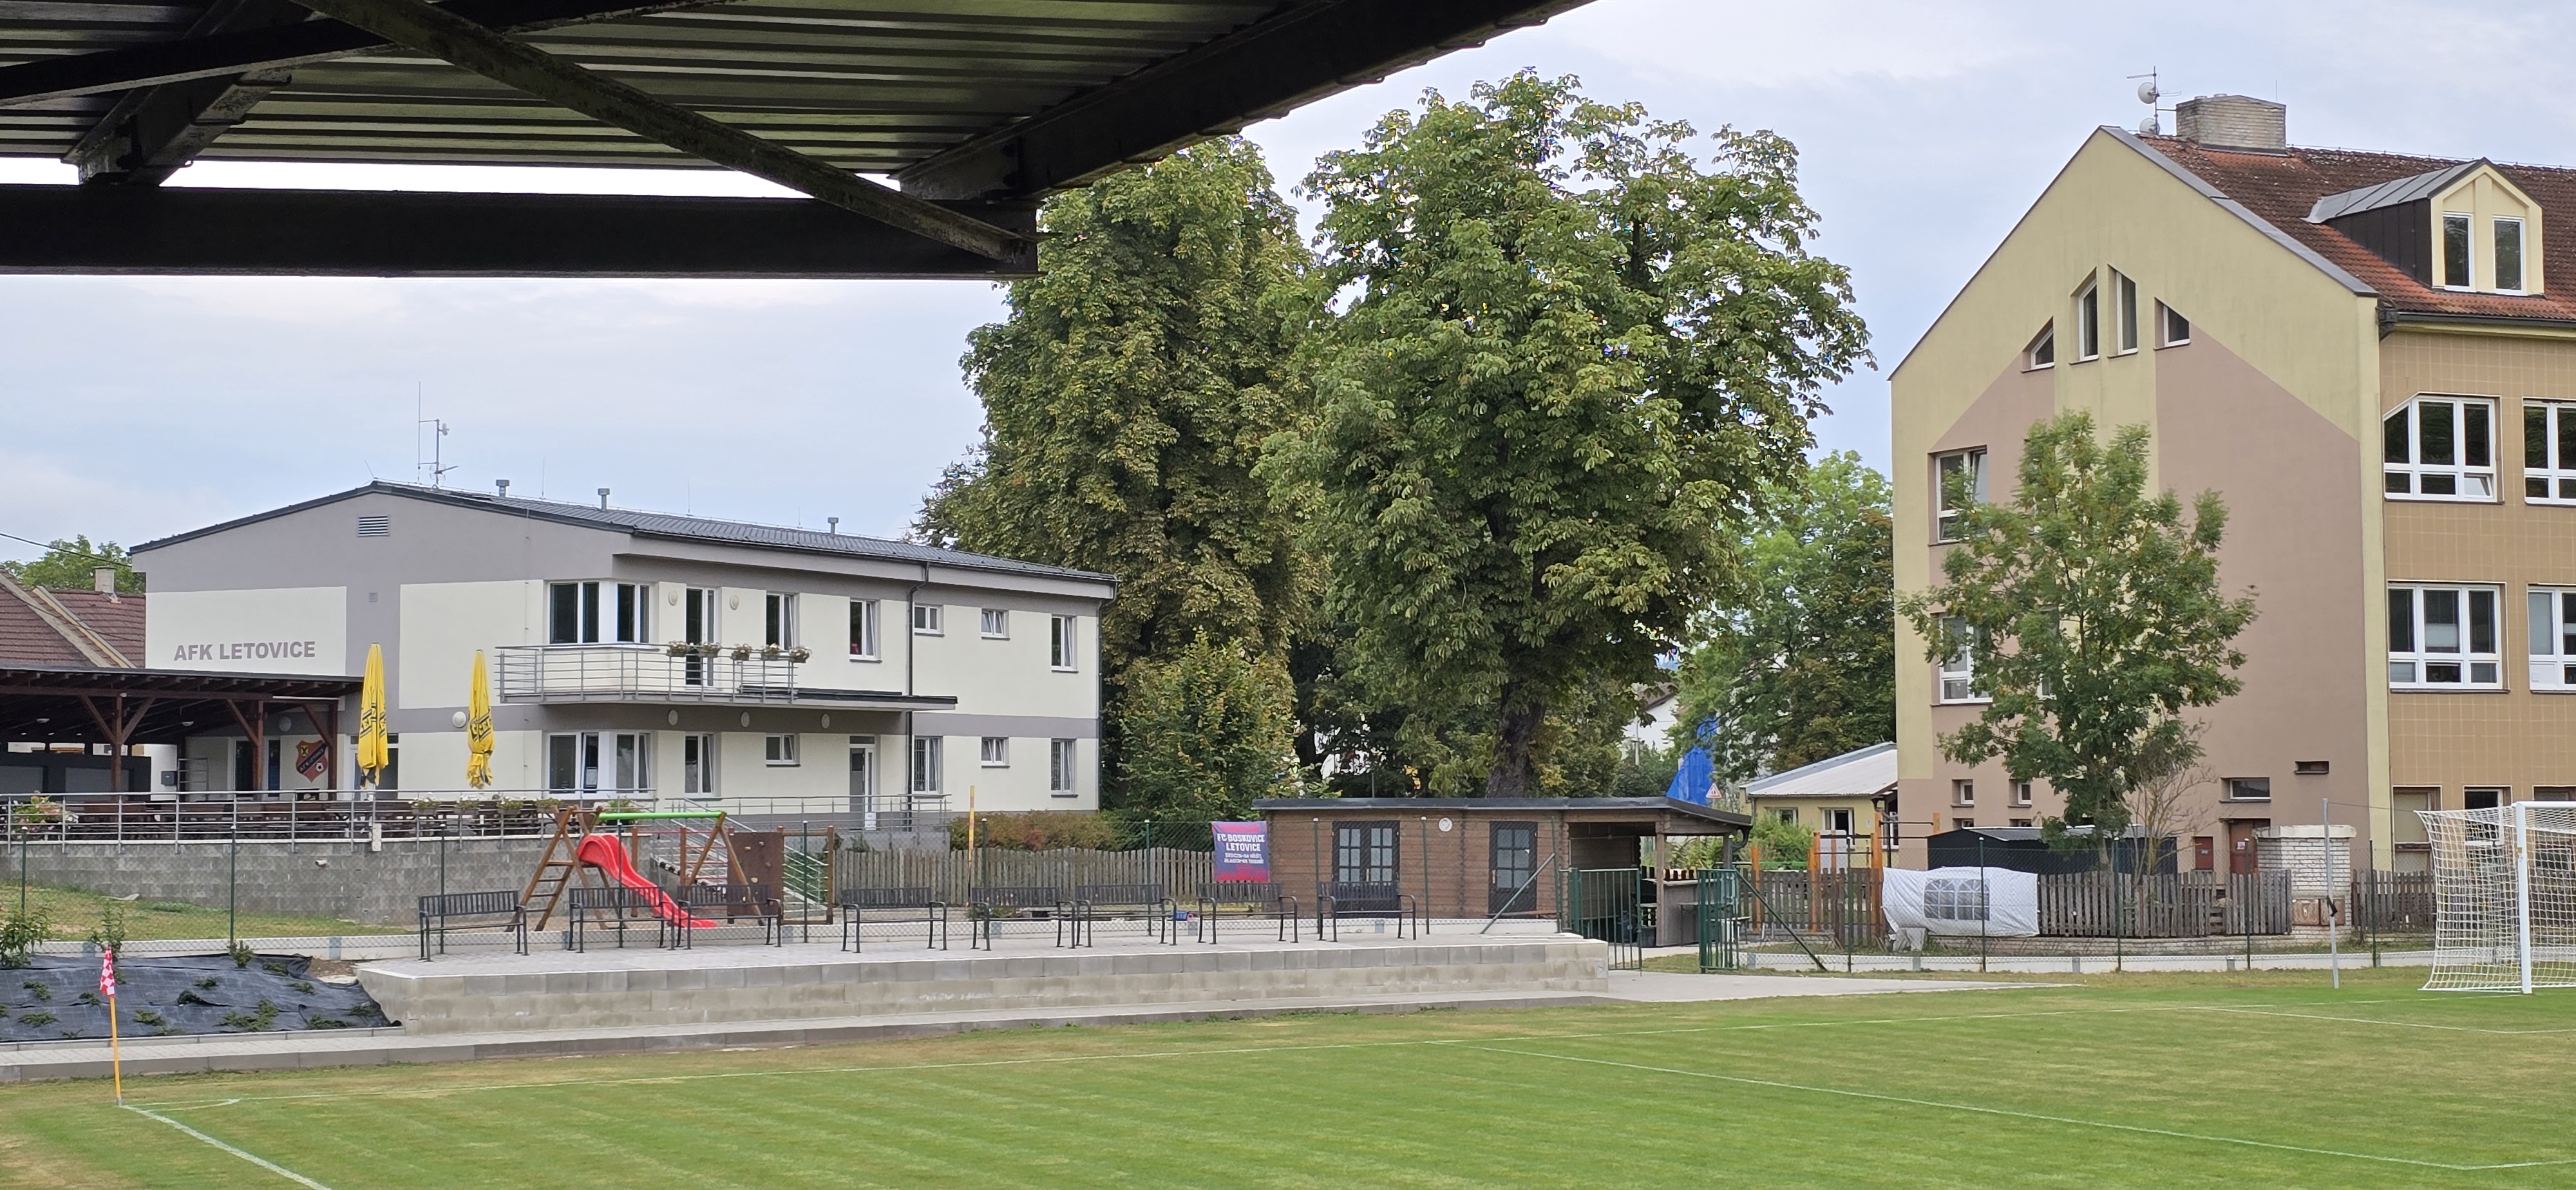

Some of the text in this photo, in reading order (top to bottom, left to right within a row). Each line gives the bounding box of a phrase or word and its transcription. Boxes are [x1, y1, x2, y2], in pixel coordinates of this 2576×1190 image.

[173, 641, 315, 661] AFK LETOVICE
[1217, 833, 1265, 842] FC BOSKOVICE
[1226, 843, 1261, 851] LETOVICE
